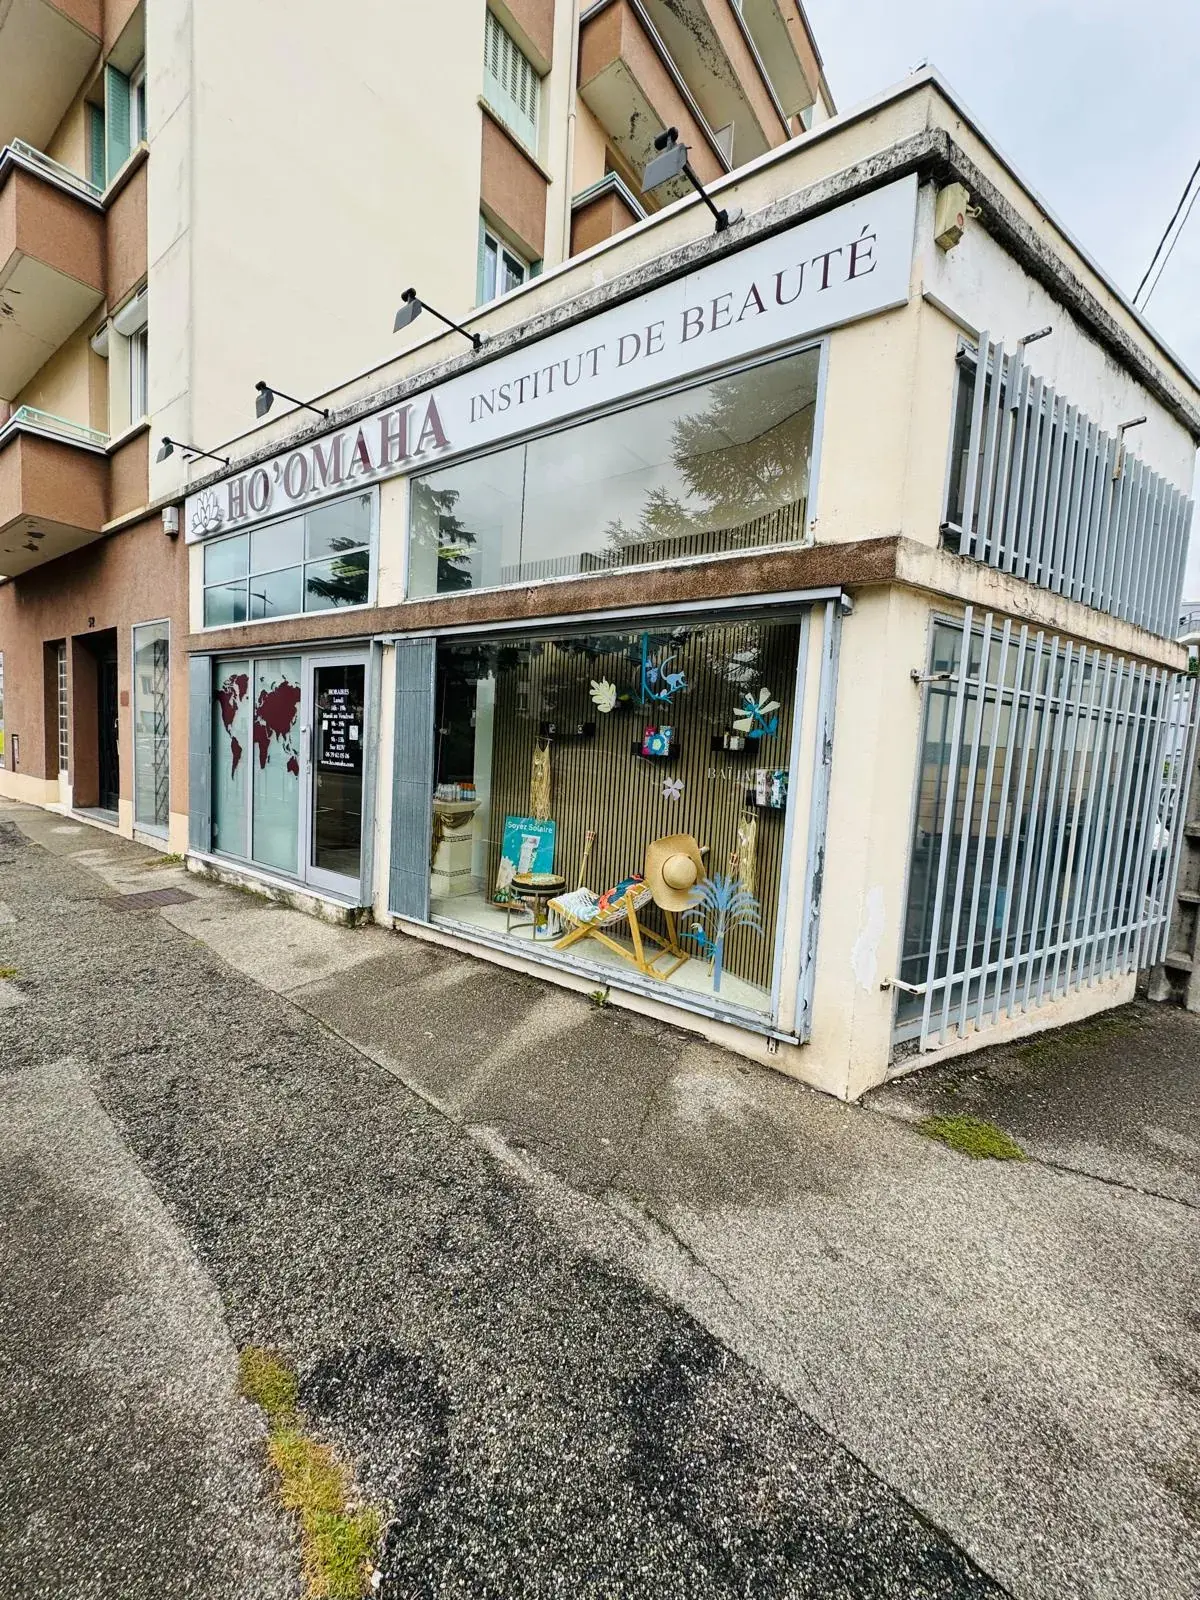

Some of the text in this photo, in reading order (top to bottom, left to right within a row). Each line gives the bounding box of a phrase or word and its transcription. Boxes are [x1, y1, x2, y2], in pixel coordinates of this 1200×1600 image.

[469, 345, 606, 423] INSTITUT
[617, 320, 665, 367] DE
[679, 224, 878, 345] BEAUTÉ
[507, 821, 553, 834] Soyez Solaire
